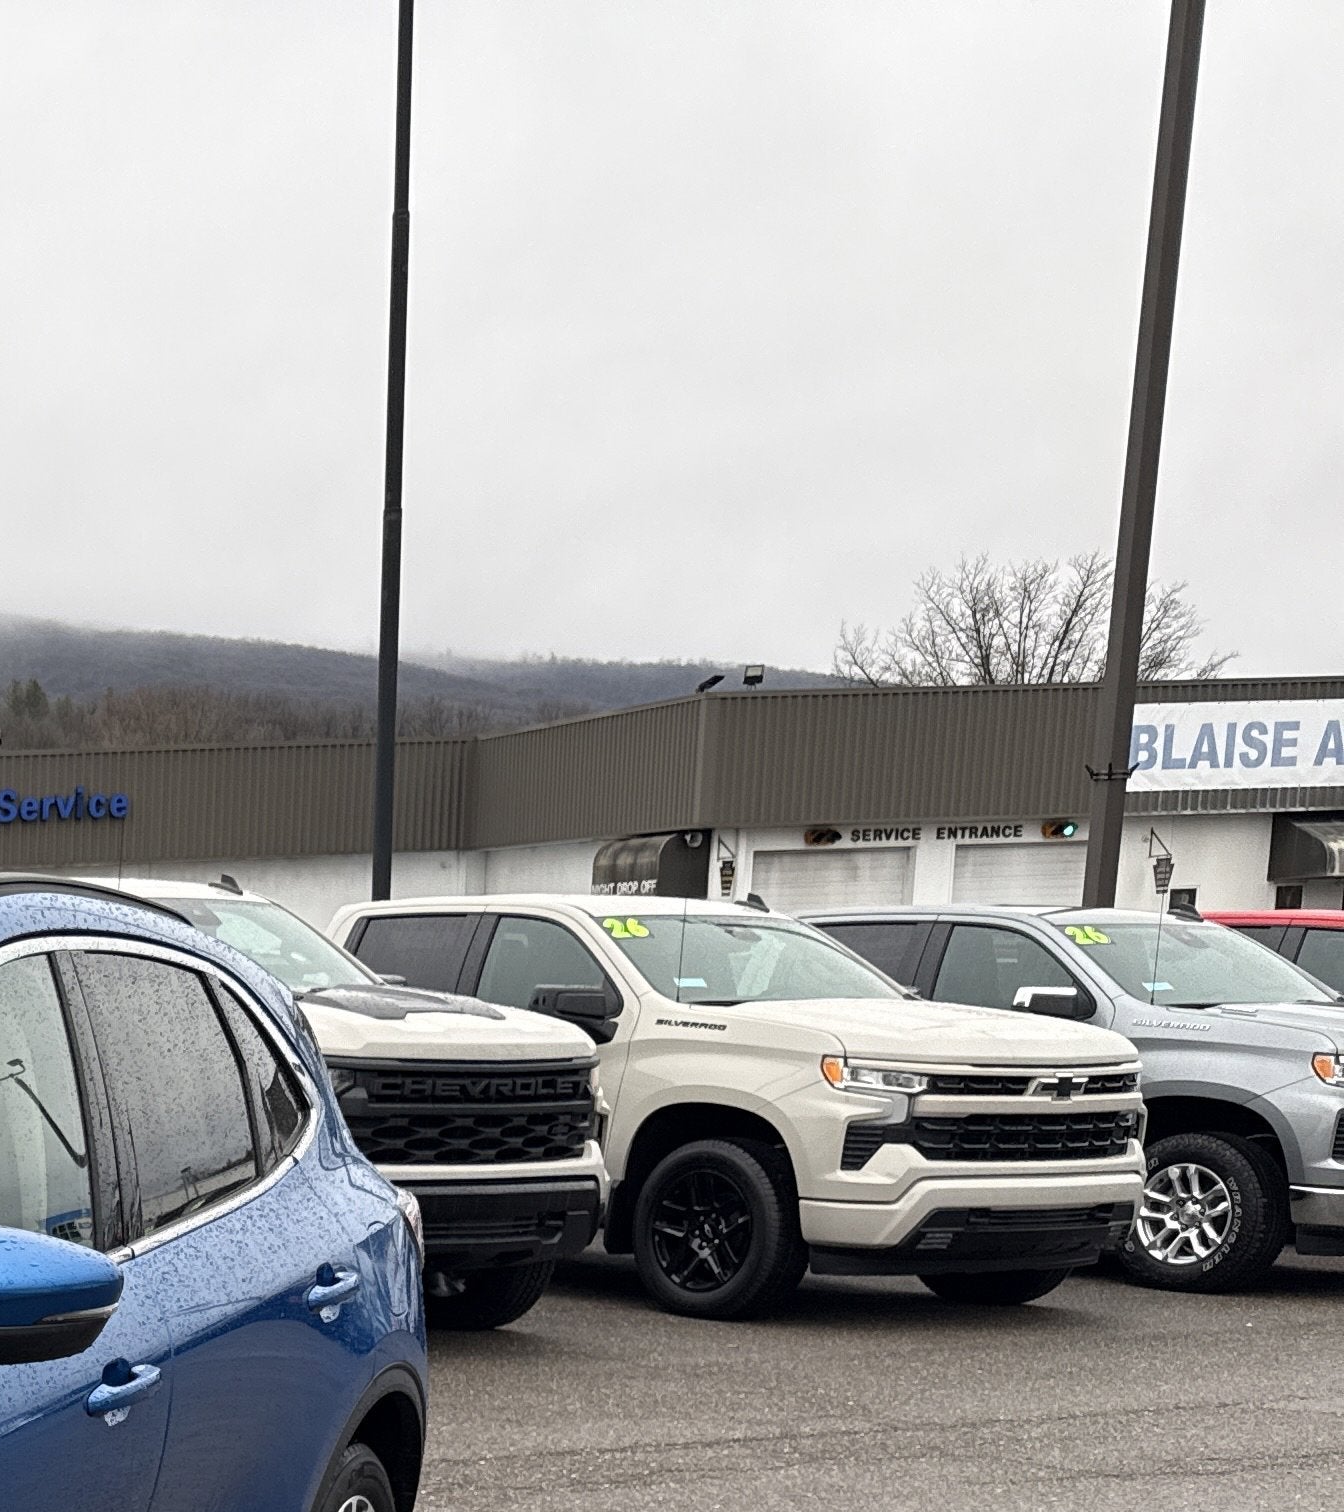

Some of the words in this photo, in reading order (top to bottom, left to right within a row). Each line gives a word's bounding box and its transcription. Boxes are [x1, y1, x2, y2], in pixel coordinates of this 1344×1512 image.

[1128, 721, 1301, 770] BLAISE
[1313, 719, 1344, 767] A
[850, 826, 922, 842] SERVICE
[936, 824, 1023, 840] ENTRANCE
[616, 880, 639, 896] DROP
[640, 879, 658, 894] OFF
[602, 917, 650, 939] 26
[1064, 926, 1112, 945] 26
[654, 1018, 728, 1031] SILVERADO
[1131, 1017, 1212, 1032] SILVERADO
[1202, 1175, 1244, 1272] WRANGLER
